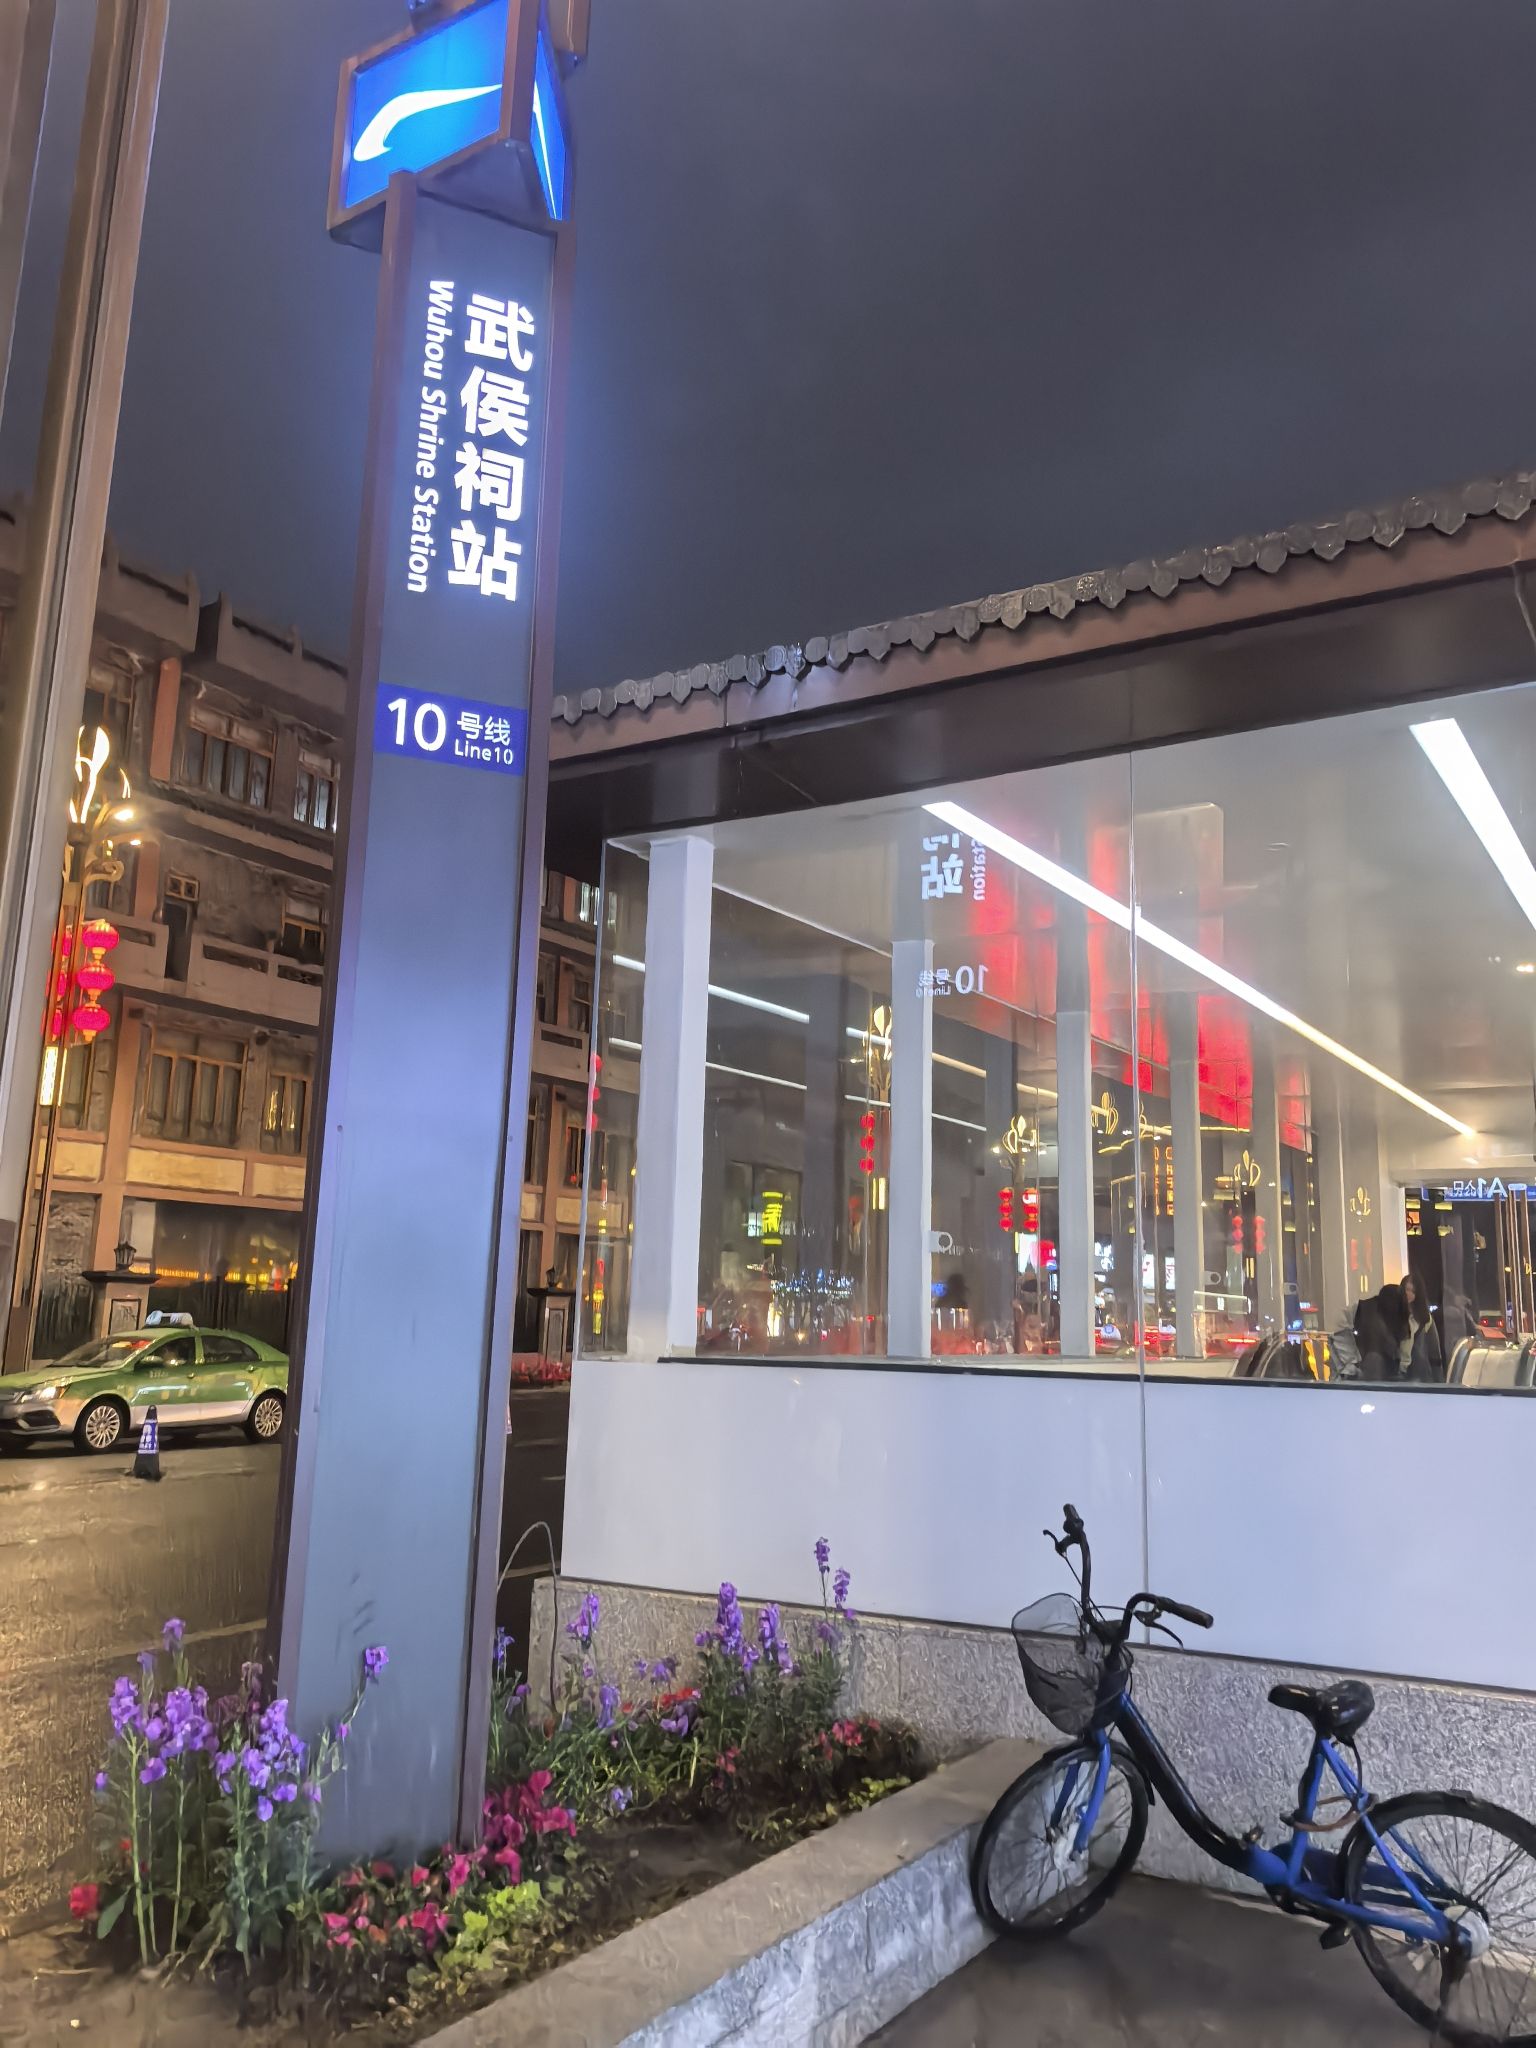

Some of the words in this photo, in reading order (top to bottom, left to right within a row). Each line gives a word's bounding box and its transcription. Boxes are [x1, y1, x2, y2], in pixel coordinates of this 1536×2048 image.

[423, 280, 454, 380] Wuhou
[411, 386, 445, 478] Shrine
[447, 293, 535, 602] 武侯祠站
[407, 485, 439, 593] Station
[388, 698, 447, 752] 10
[456, 711, 511, 746] 号线
